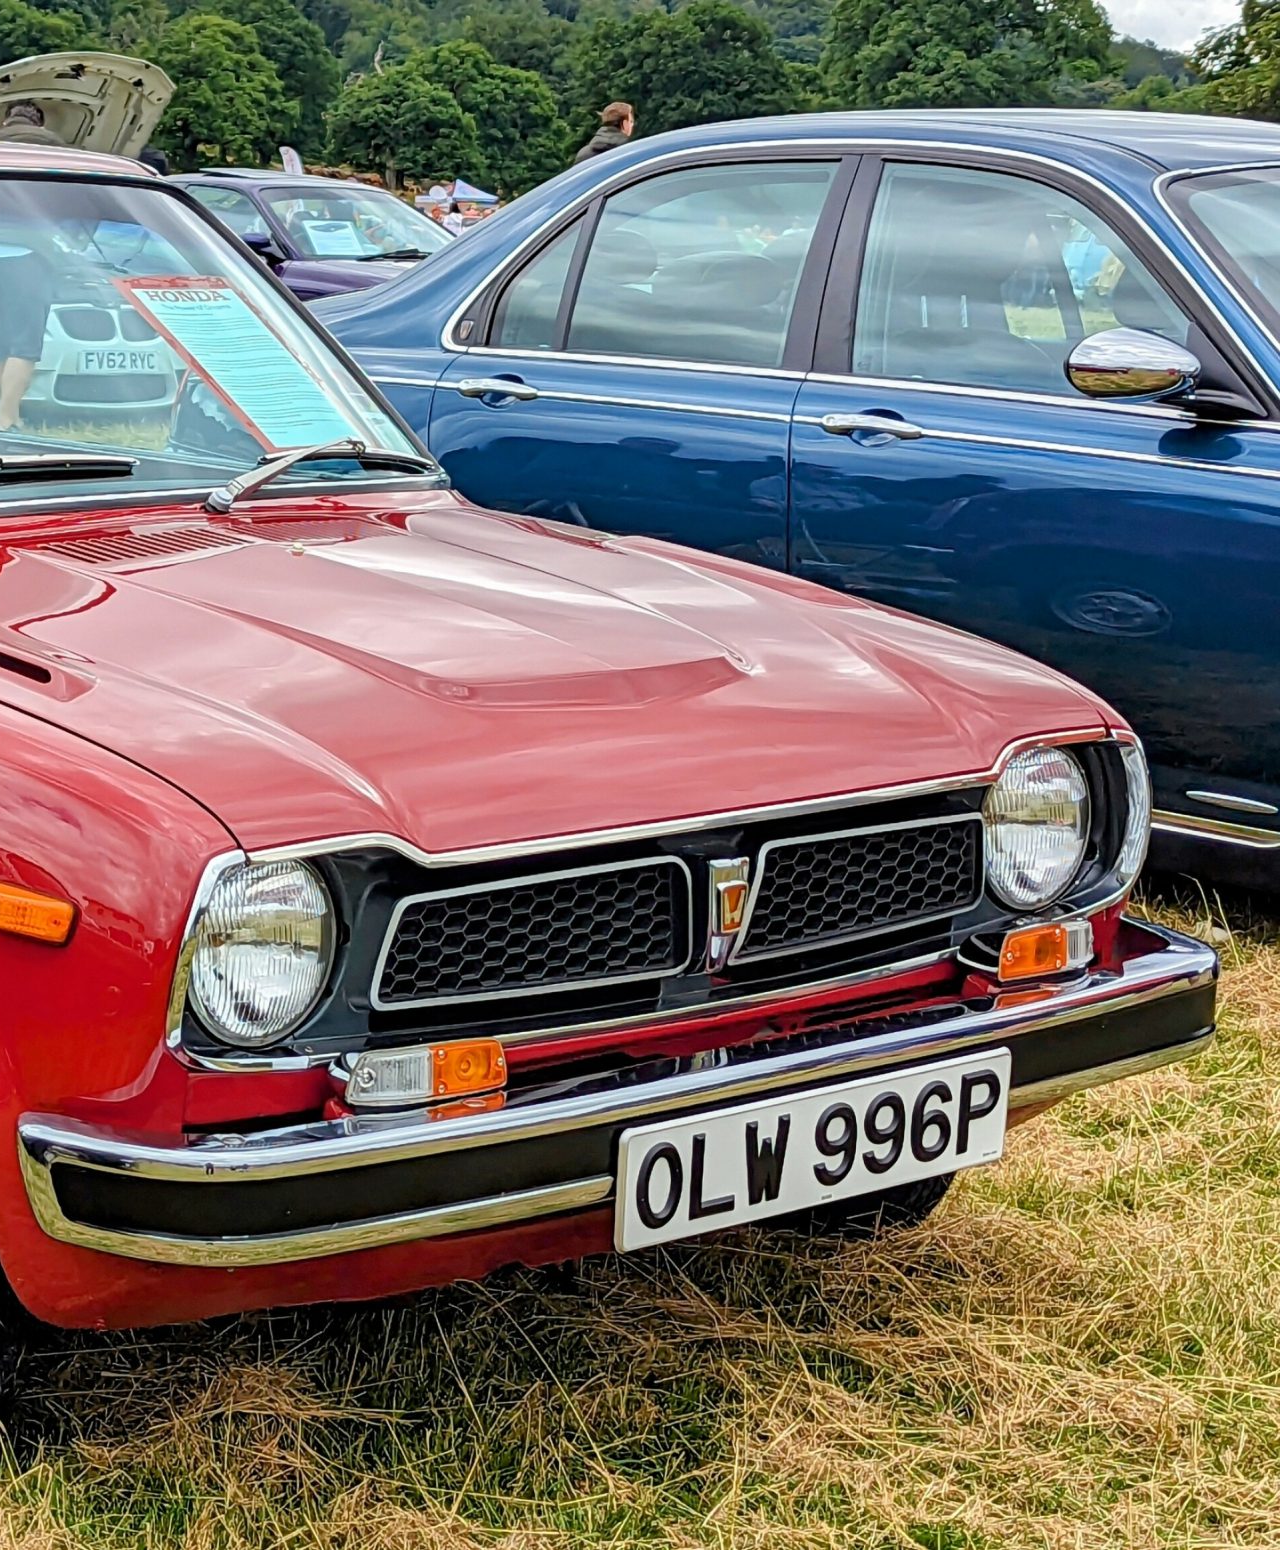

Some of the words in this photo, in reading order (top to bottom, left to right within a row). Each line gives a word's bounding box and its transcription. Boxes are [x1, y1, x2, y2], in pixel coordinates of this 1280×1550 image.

[144, 290, 231, 302] HONDA
[85, 352, 126, 370] FV62
[129, 352, 155, 370] RYC
[636, 1113, 791, 1229] OLW
[812, 1068, 1002, 1187] 996P
